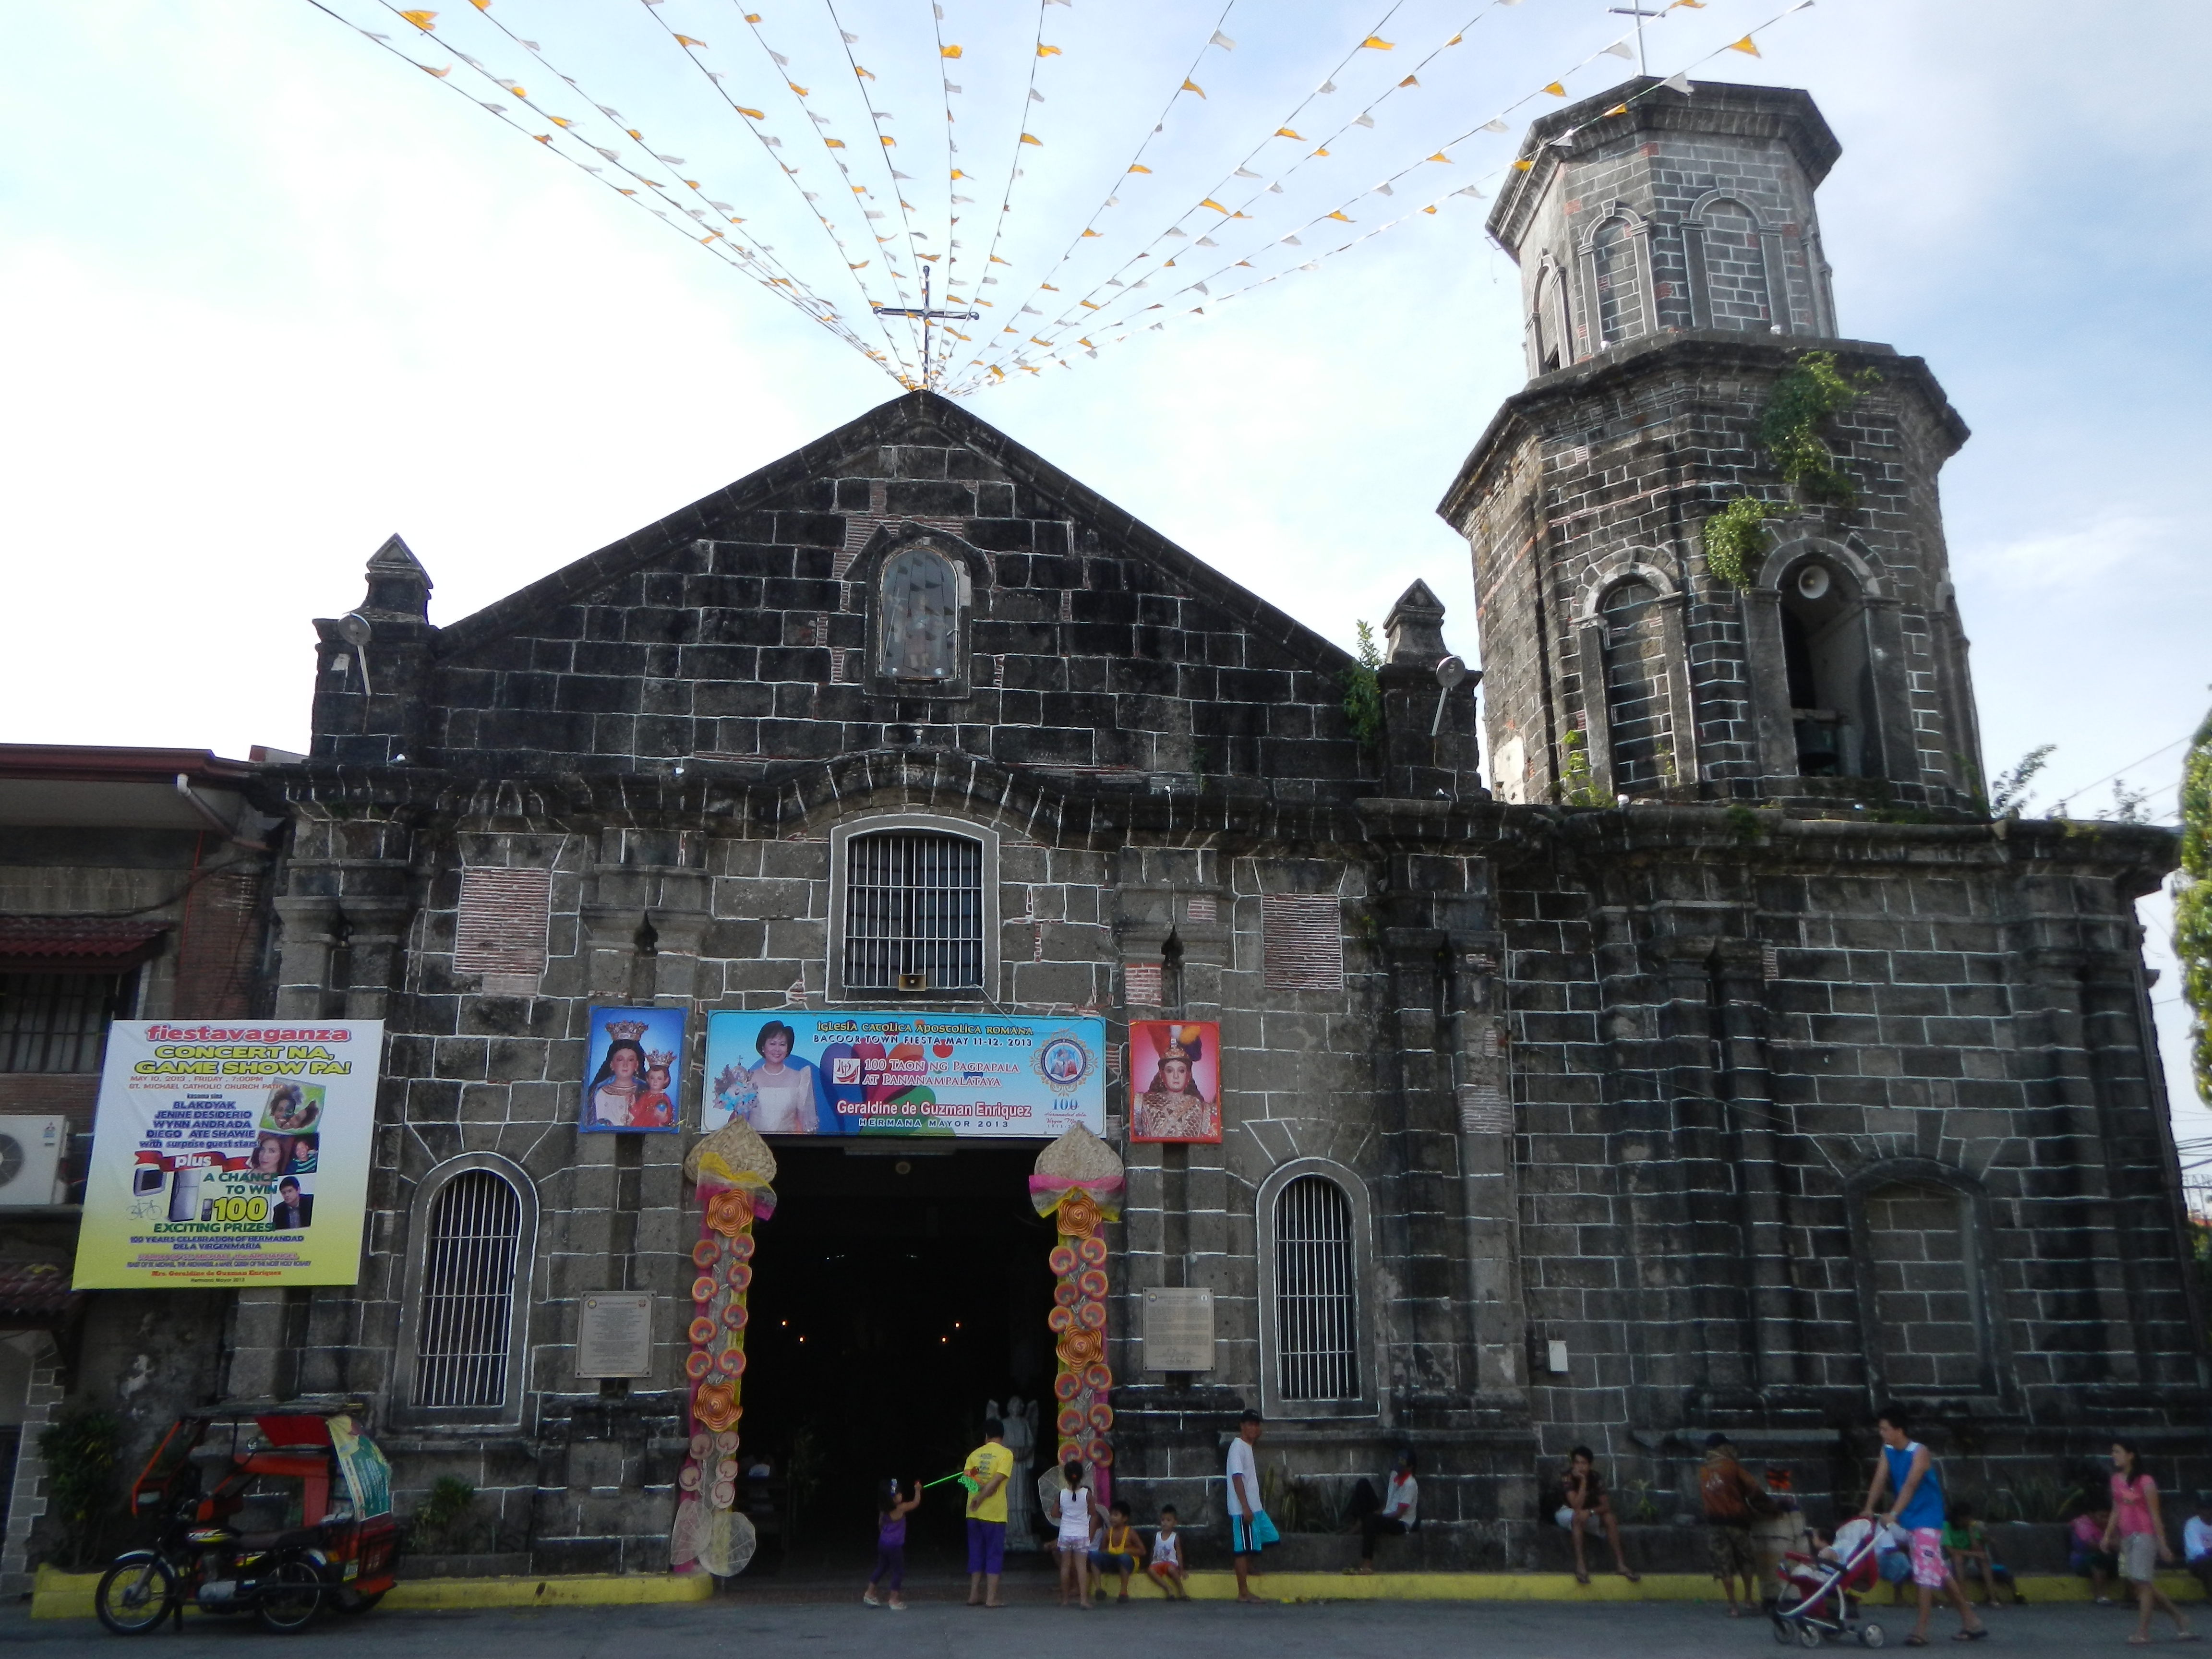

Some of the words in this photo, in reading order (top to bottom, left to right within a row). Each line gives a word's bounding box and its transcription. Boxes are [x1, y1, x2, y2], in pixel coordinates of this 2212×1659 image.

[146, 1024, 351, 1044] fiestavaganza
[814, 1034, 861, 1043] BACOOR
[866, 1035, 898, 1044] TOWN
[904, 1035, 941, 1045] FIESTA
[945, 1037, 969, 1046] MAY
[1008, 1038, 1032, 1046] 2013
[155, 1045, 284, 1059] CONCERT
[287, 1046, 335, 1060] NA,
[134, 1061, 218, 1074] GAME
[222, 1061, 307, 1074] SHOW
[309, 1061, 351, 1075] PA!
[864, 1058, 886, 1070] 100
[890, 1059, 925, 1071] TAON
[929, 1062, 948, 1071] NG
[953, 1061, 1019, 1073] PAGPAPALA
[862, 1075, 879, 1085] AT
[882, 1073, 1002, 1087] PANANAMPALATAYA
[172, 1101, 236, 1109] BLAKDYAK
[837, 1099, 898, 1115] Geraldine
[901, 1101, 917, 1115] de
[921, 1101, 972, 1116] Guzman
[975, 1102, 1032, 1120] Enriquez
[1053, 1098, 1078, 1110] 100
[154, 1111, 192, 1119] JENINE
[193, 1111, 252, 1119] DESIDERIO
[153, 1120, 191, 1129] WYNN
[192, 1120, 252, 1129] ANDRADA
[858, 1118, 922, 1127] HERMANA
[929, 1119, 970, 1128] MAYOR
[145, 1130, 182, 1138] DIEGO
[188, 1130, 211, 1138] ATE
[211, 1130, 256, 1138] SHAWIE
[139, 1139, 162, 1148] with
[166, 1140, 205, 1149] surprise
[206, 1140, 233, 1149] guest
[174, 1154, 211, 1168] plus
[203, 1173, 215, 1182] A
[218, 1173, 278, 1182] CHANCE
[226, 1185, 245, 1194] TO
[250, 1185, 278, 1194] WIN
[214, 1196, 268, 1222] 100
[154, 1223, 220, 1233] EXCITING
